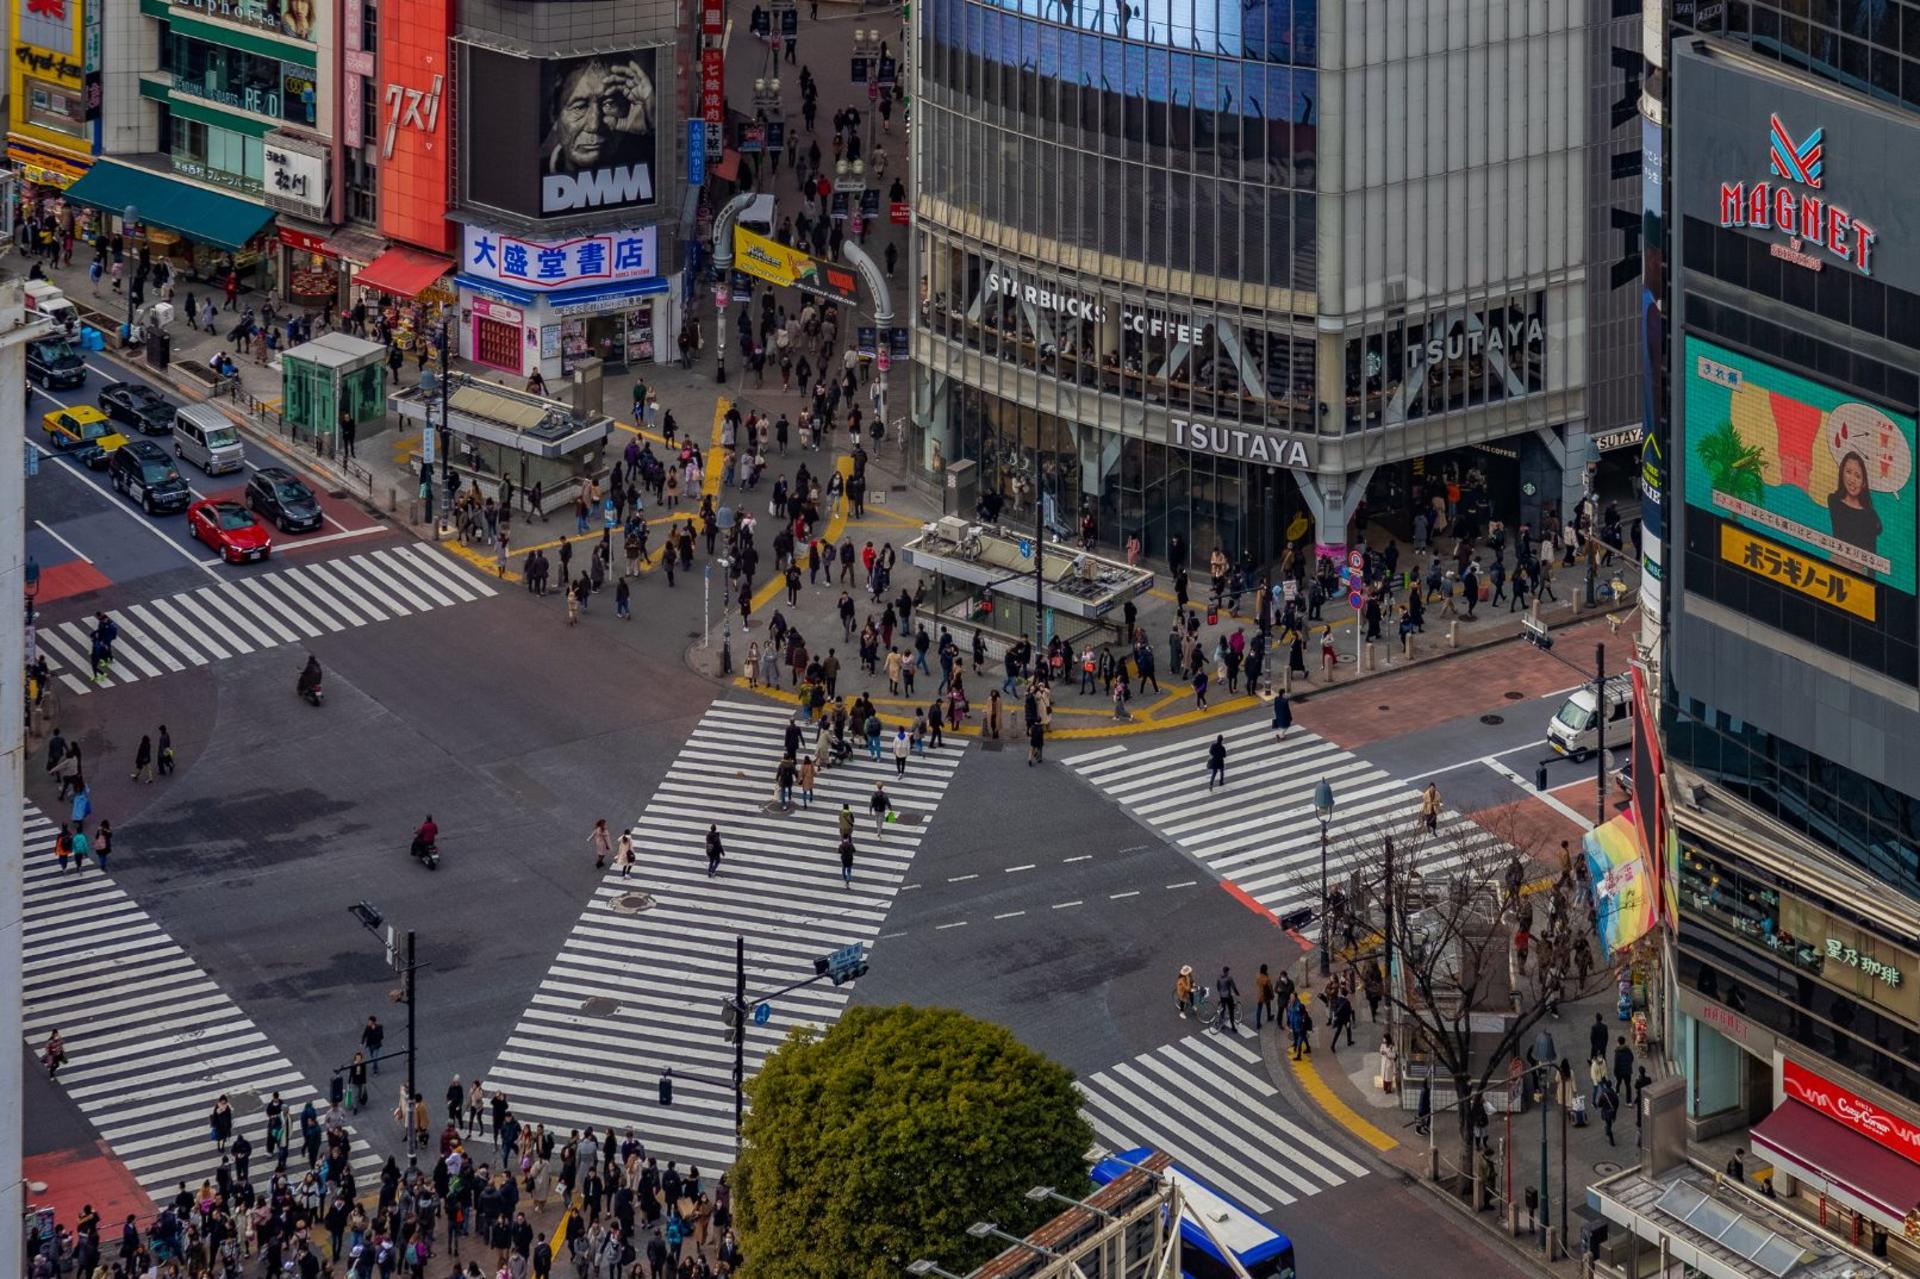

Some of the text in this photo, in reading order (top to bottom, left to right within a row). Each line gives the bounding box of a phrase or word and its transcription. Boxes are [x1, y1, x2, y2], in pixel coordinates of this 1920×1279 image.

[179, 0, 275, 26] uphoria
[542, 163, 653, 213] DMM
[1720, 181, 1876, 276] MAGNET
[473, 235, 644, 279] 大盛堂書店
[989, 273, 1204, 347] STARBUCKS COFFEE
[1407, 317, 1544, 369] TSUTAYA
[1171, 418, 1310, 468] TSUTAYA
[1743, 541, 1849, 604] ボラギノール
[1826, 938, 1901, 988] 星乃珈琲
